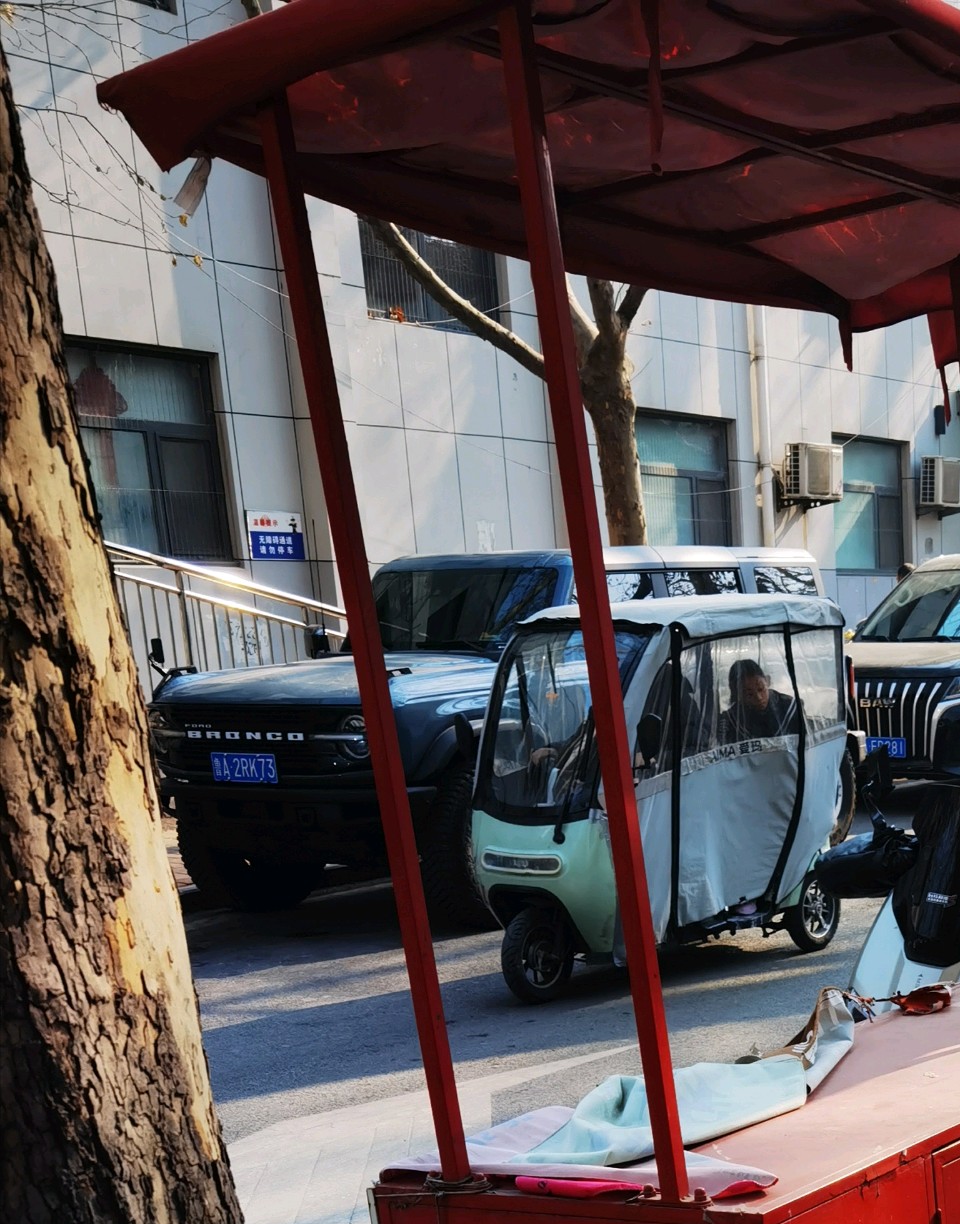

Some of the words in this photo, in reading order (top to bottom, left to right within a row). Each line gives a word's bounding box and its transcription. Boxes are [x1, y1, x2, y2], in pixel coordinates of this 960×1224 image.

[860, 698, 895, 708] BAW
[187, 730, 305, 741] BRONCO
[740, 741, 762, 754] 爱玛
